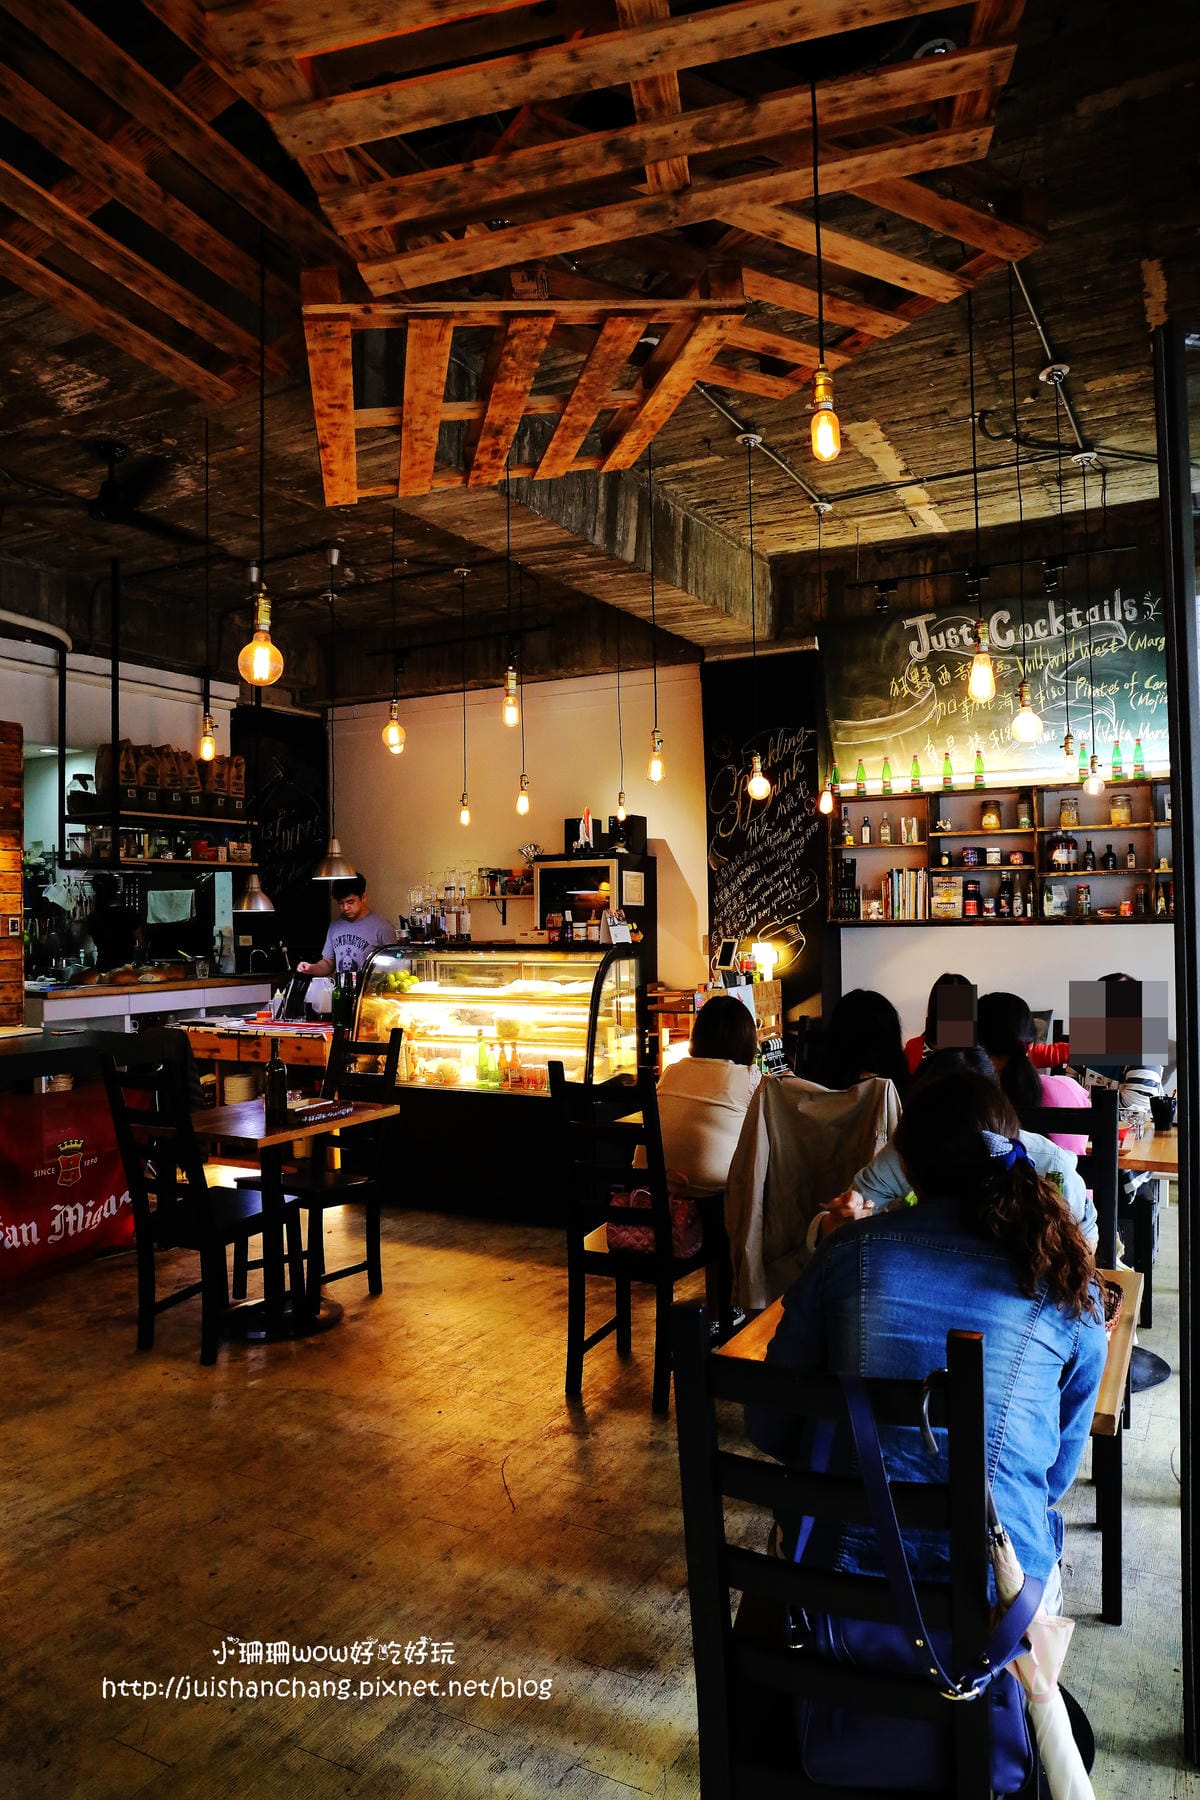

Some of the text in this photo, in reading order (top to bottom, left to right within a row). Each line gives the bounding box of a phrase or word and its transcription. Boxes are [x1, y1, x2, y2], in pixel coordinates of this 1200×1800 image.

[902, 588, 1137, 660] Just Cocktails
[33, 1167, 56, 1178] SINCE
